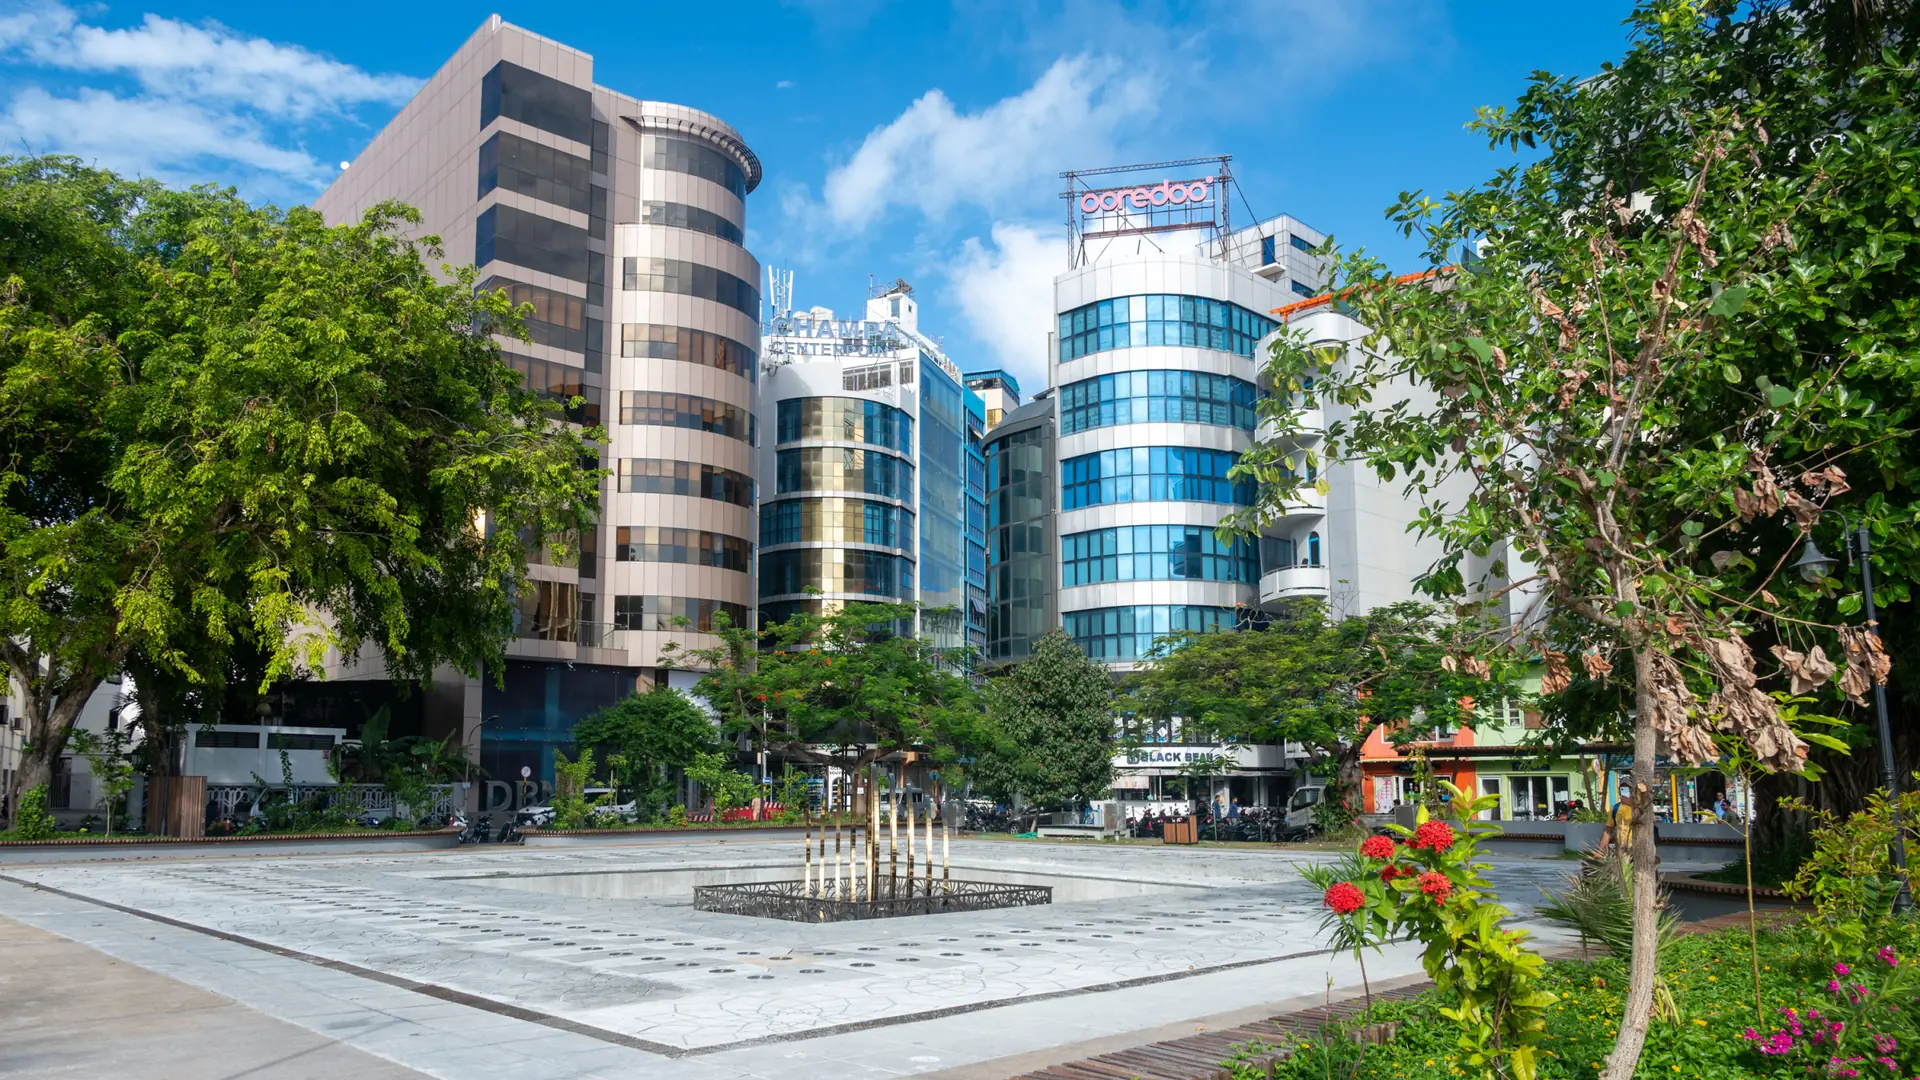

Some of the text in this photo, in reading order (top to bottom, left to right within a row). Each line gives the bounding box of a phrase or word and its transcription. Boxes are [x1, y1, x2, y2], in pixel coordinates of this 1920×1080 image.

[1080, 177, 1213, 213] ooredoo
[771, 317, 898, 341] CHAMPA
[770, 341, 898, 358] CENTERPOINT
[1140, 751, 1214, 763] BLACK BEAN
